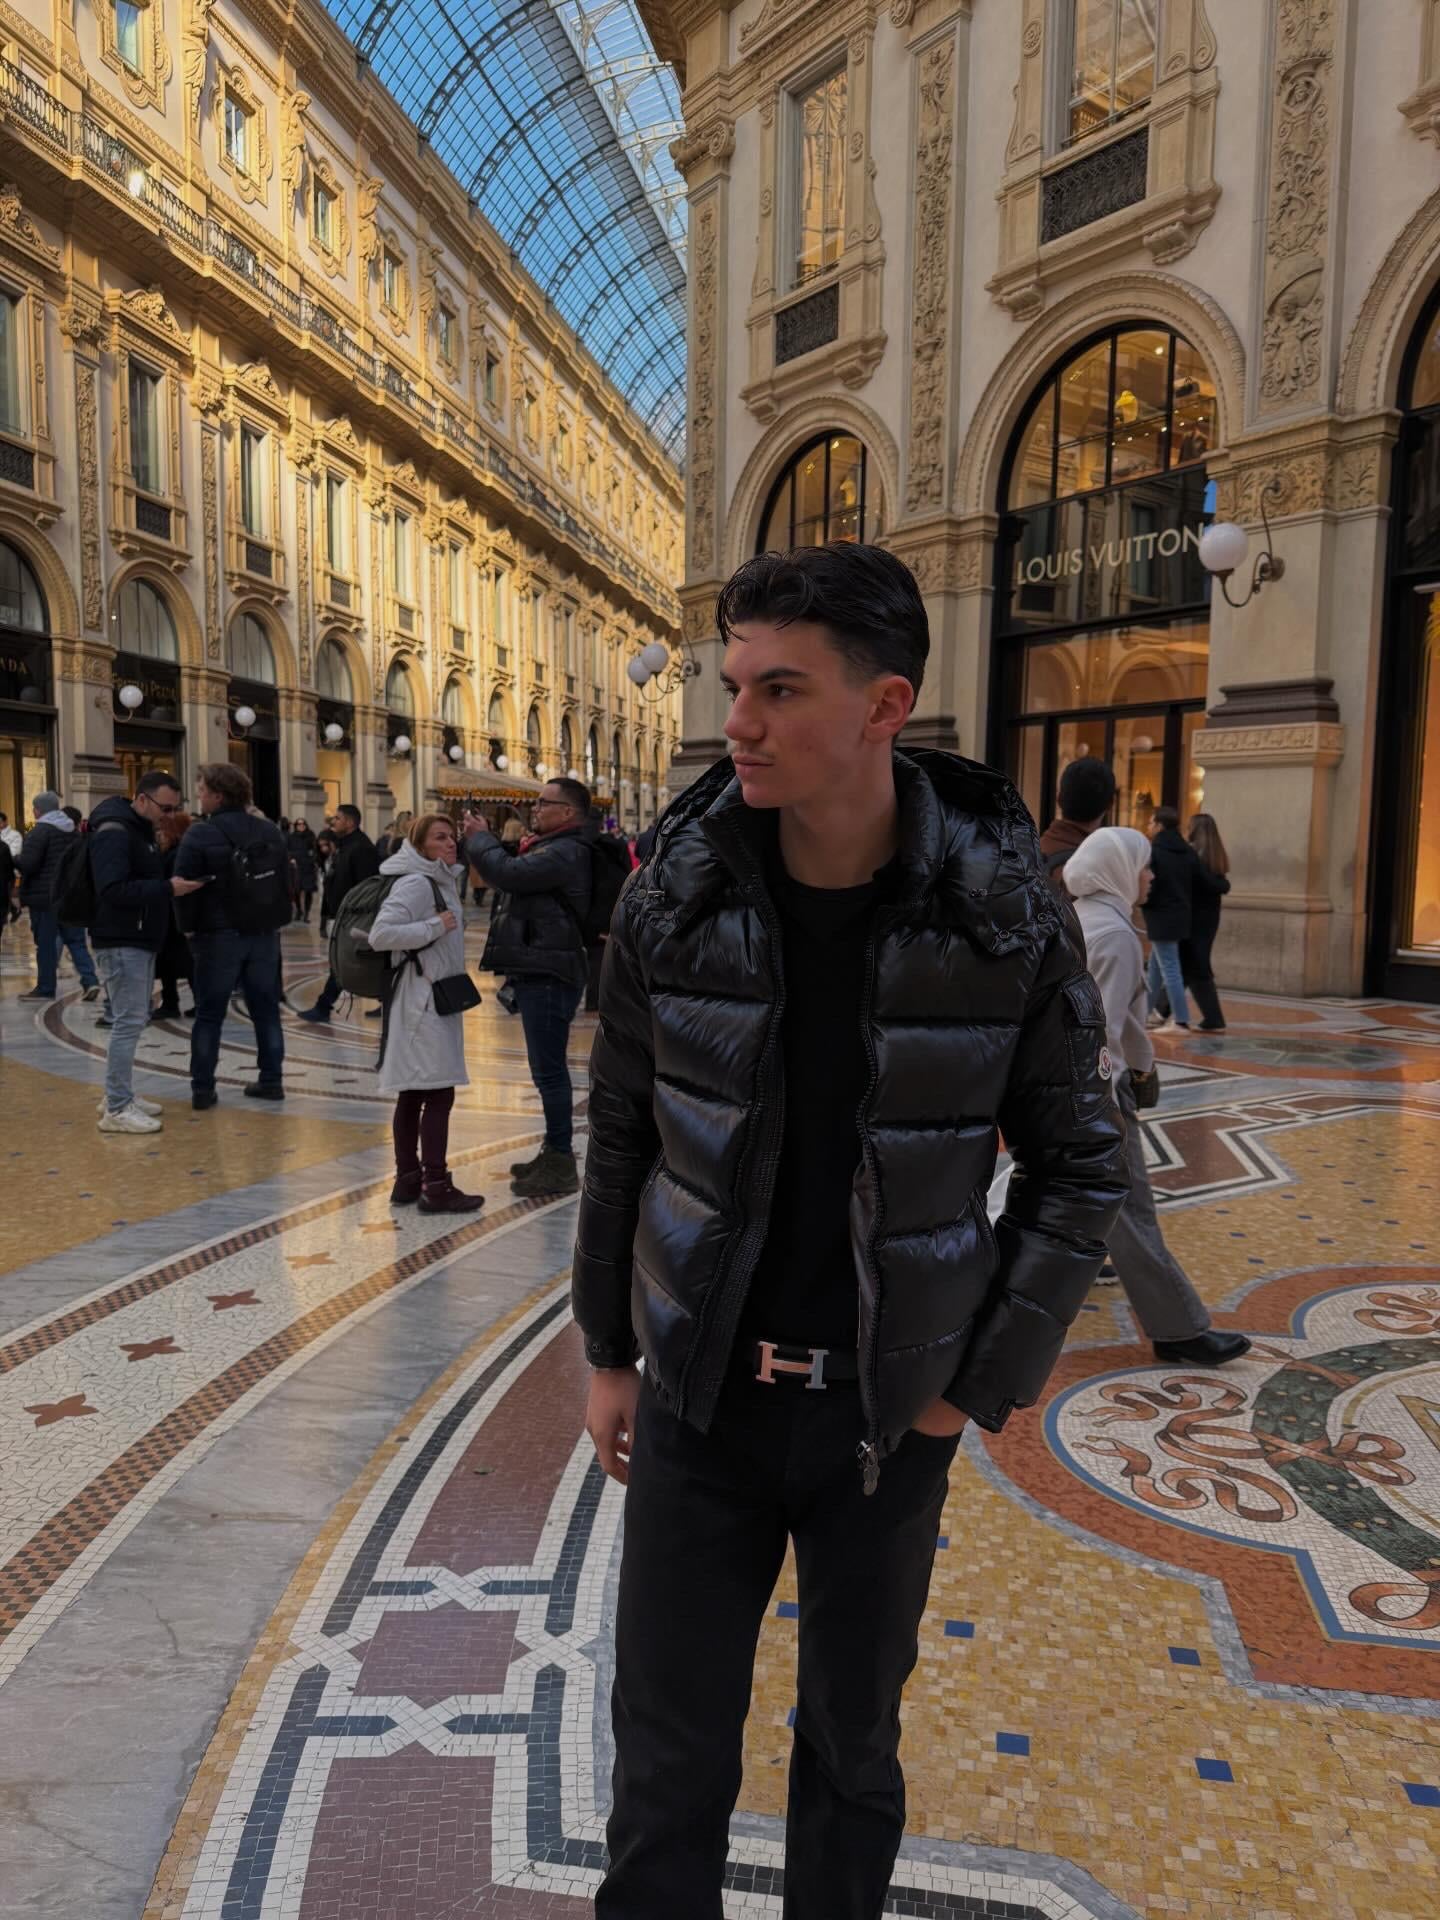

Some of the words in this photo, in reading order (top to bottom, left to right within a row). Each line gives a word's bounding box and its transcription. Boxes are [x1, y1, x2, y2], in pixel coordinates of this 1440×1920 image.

[1016, 548, 1083, 585] LOUIS
[1090, 522, 1204, 569] VUITTON
[756, 1341, 829, 1389] H
